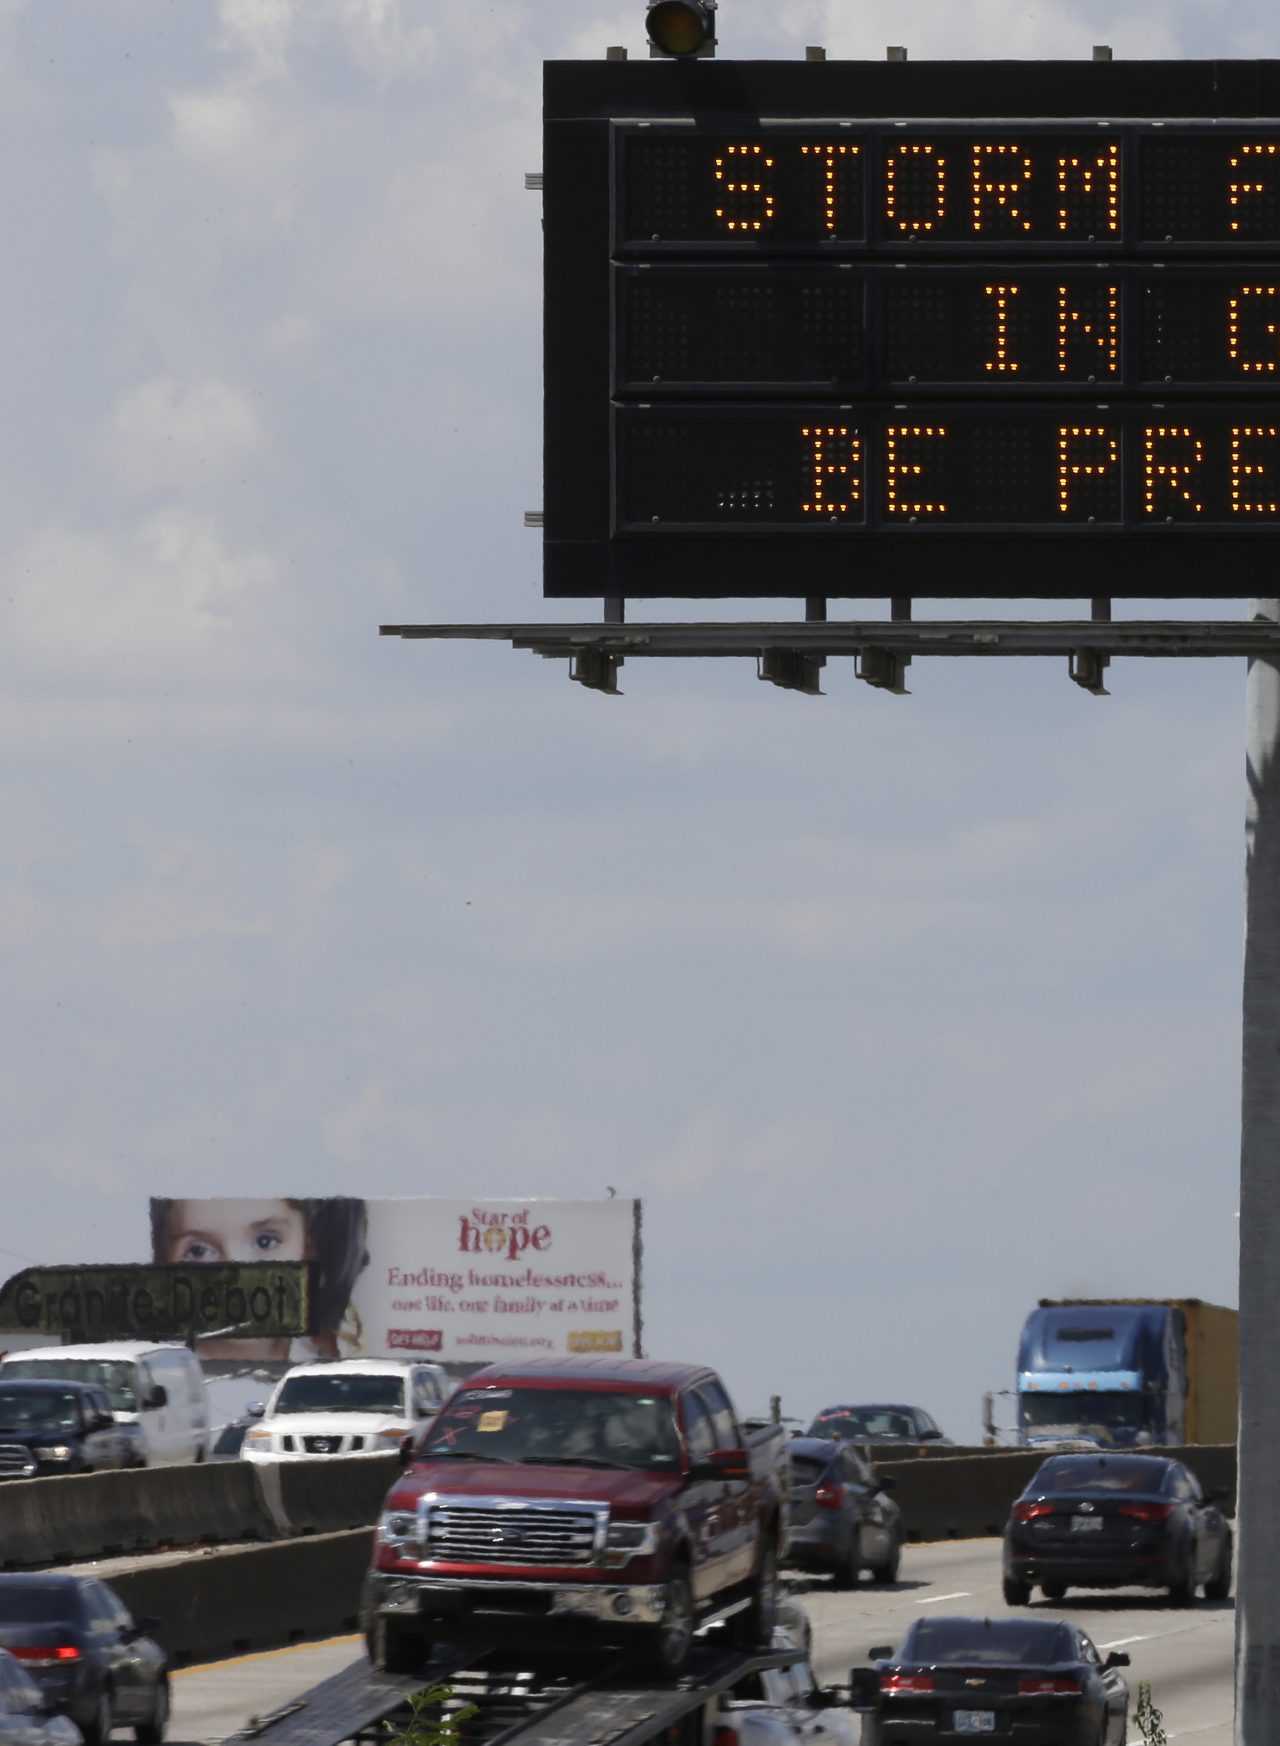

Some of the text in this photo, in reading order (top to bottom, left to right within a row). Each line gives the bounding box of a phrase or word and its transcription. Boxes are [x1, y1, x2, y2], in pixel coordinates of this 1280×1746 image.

[714, 143, 1118, 230] STORM
[984, 285, 1118, 372] IN
[800, 426, 946, 513] BE
[458, 1215, 552, 1261] hope
[472, 1208, 530, 1226] Star of
[387, 1267, 464, 1294] Ending
[492, 1296, 547, 1317] family
[581, 1297, 619, 1314] time
